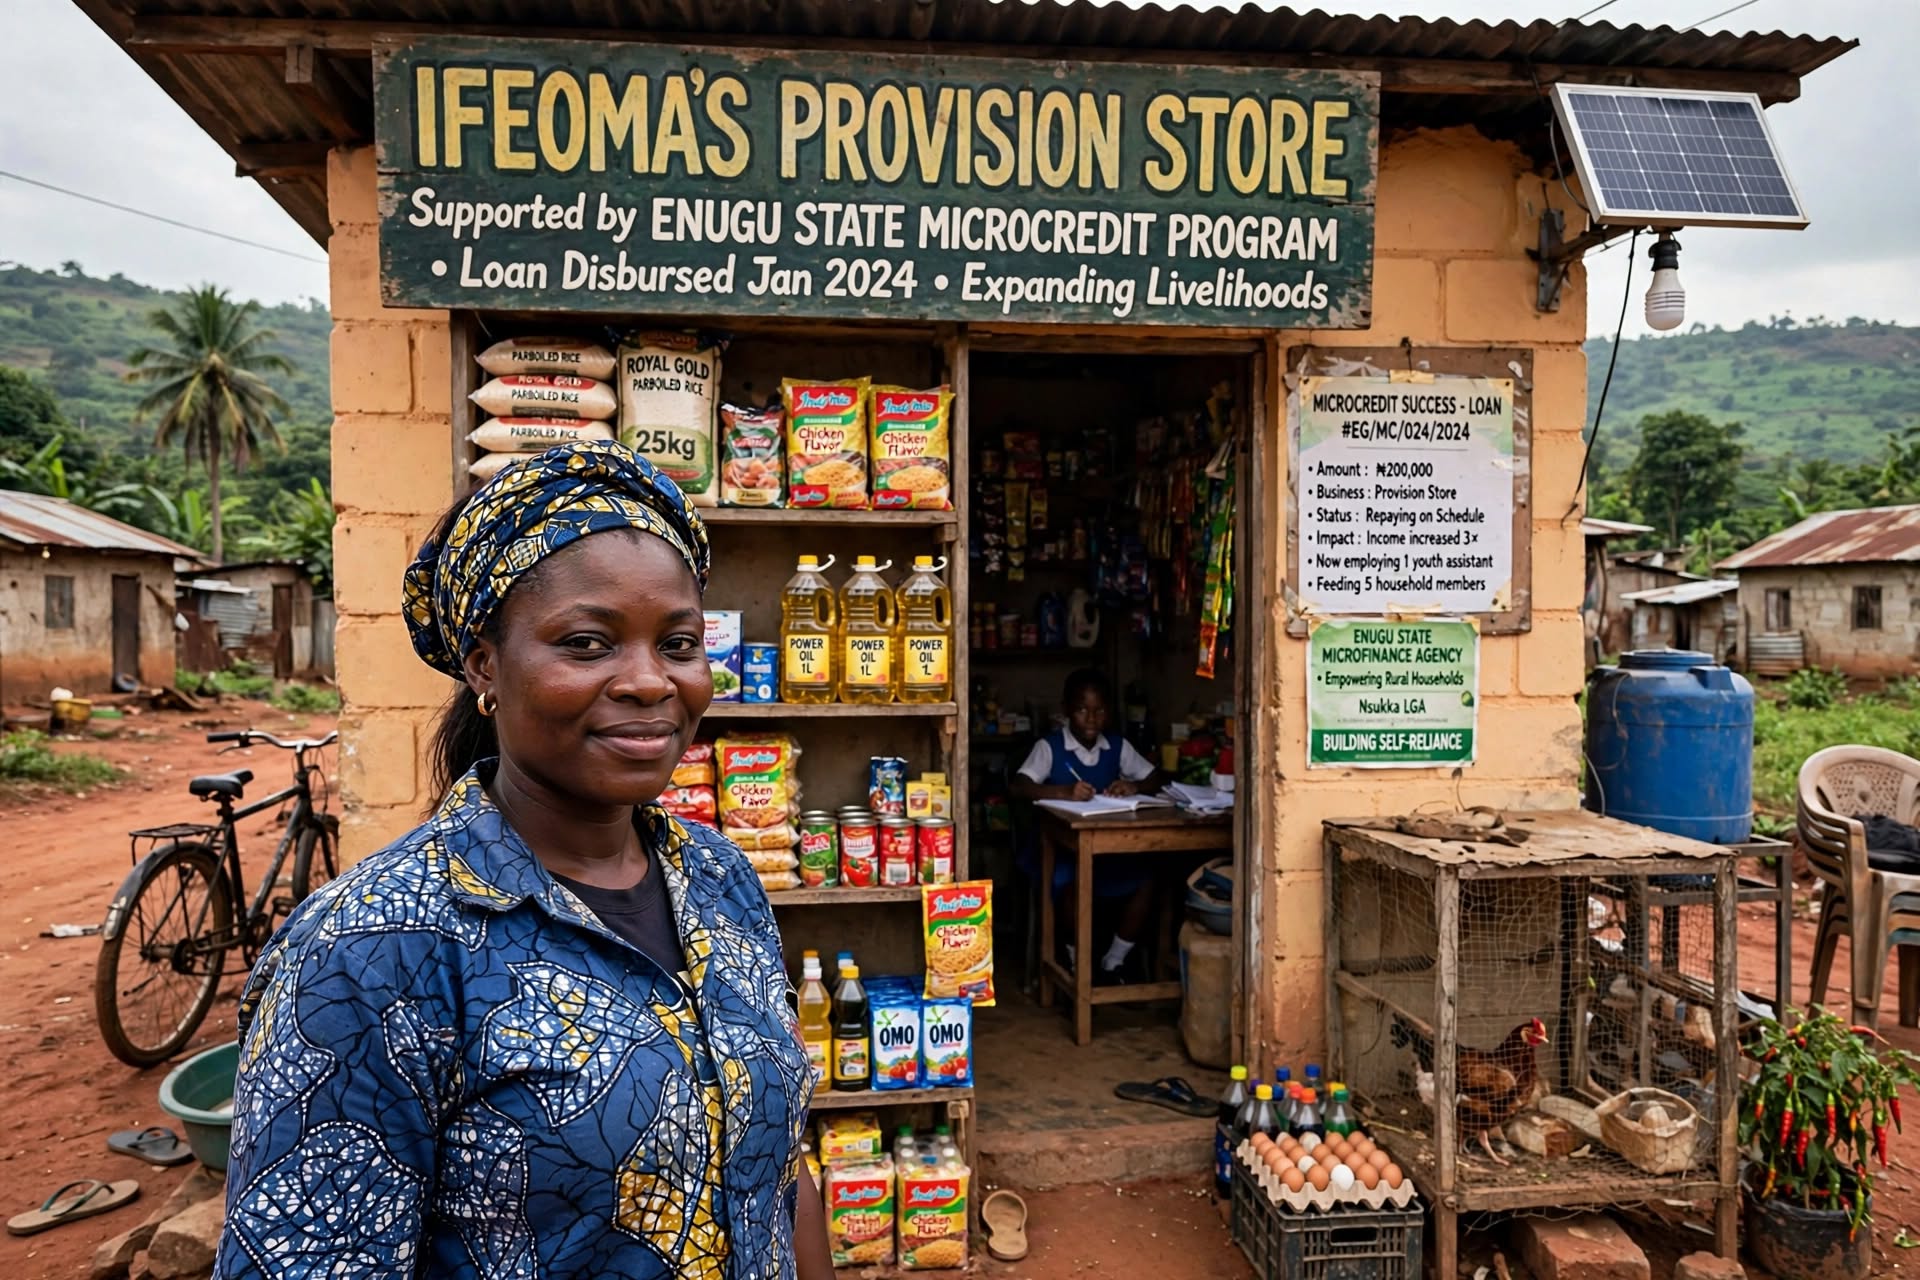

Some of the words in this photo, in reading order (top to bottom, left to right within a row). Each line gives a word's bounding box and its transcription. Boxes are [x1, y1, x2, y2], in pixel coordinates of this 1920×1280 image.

[416, 66, 750, 178] IFEOMA'S
[781, 80, 1121, 189] PROVISION
[1145, 94, 1350, 197] STORE
[408, 186, 584, 240] Supported
[597, 192, 637, 243] by
[652, 198, 782, 245] ENUGU
[794, 202, 905, 249] STATE
[918, 205, 1156, 256] MICROCREDIT
[1168, 213, 1338, 262] PROGRAM
[459, 246, 547, 290] Loan
[561, 249, 736, 295] Disbursed
[747, 256, 812, 297] Jan
[824, 258, 917, 299] 2024
[961, 262, 1136, 319] Expanding
[1147, 266, 1329, 311] Livelihoods
[512, 351, 559, 361] PARBOILED
[561, 352, 581, 363] RICE
[627, 355, 670, 375] ROYAL
[674, 357, 710, 380] GOLD
[633, 377, 681, 391] PARBOILED
[685, 380, 703, 396] RICE
[512, 389, 559, 401] PARBOILED
[561, 391, 579, 403] RICE
[1313, 394, 1398, 414] MICROCREDIT
[1402, 395, 1456, 415] SUCCESS
[1469, 396, 1502, 415] LOAN
[510, 427, 557, 438] PARBOILED
[799, 427, 844, 439] Chicken
[882, 432, 928, 444] Chicken
[1342, 421, 1470, 442] #EG/MC/024/2024
[636, 430, 696, 461] 25kg
[1316, 461, 1361, 477] Amount
[1316, 485, 1365, 500] Business
[1374, 484, 1425, 500] Provision
[1428, 485, 1457, 500] Store
[1316, 507, 1352, 523] Status
[1366, 509, 1416, 526] Repaying
[1419, 512, 1433, 522] on
[1436, 507, 1485, 523] Schedule
[1316, 531, 1355, 549] Impact
[1366, 531, 1406, 545] Income
[1409, 530, 1460, 545] increased
[1316, 554, 1341, 568] Now
[1344, 554, 1400, 572] employing
[1404, 554, 1409, 568] 1
[1412, 554, 1443, 572] youth
[1446, 554, 1494, 568] assistant
[1316, 576, 1361, 594] Feeding
[1365, 577, 1372, 590] 5
[1376, 575, 1433, 591] household
[1436, 576, 1486, 591] members
[790, 638, 824, 649] POWER
[851, 639, 885, 650] POWER
[909, 639, 943, 650] POWER
[1354, 629, 1394, 644] ENUGU
[1397, 629, 1432, 644] STATE
[799, 650, 815, 662] OIL
[860, 651, 876, 663] OIL
[919, 652, 935, 663] OIL
[1322, 647, 1412, 663] MICROFINANCE
[1415, 647, 1463, 663] AGENCY
[801, 663, 812, 674] 1L
[861, 664, 872, 676] 1L
[1325, 671, 1382, 689] Empowering
[1385, 671, 1409, 685] Rural
[1411, 670, 1464, 686] Households
[1359, 697, 1399, 714] Nsukka
[1404, 698, 1426, 714] LGA
[1322, 733, 1377, 751] BUILDING
[1378, 732, 1463, 751] SELF-RELIANCE
[731, 783, 773, 796] Chicken
[879, 1025, 914, 1047] OMO
[929, 1023, 964, 1044] OMO
